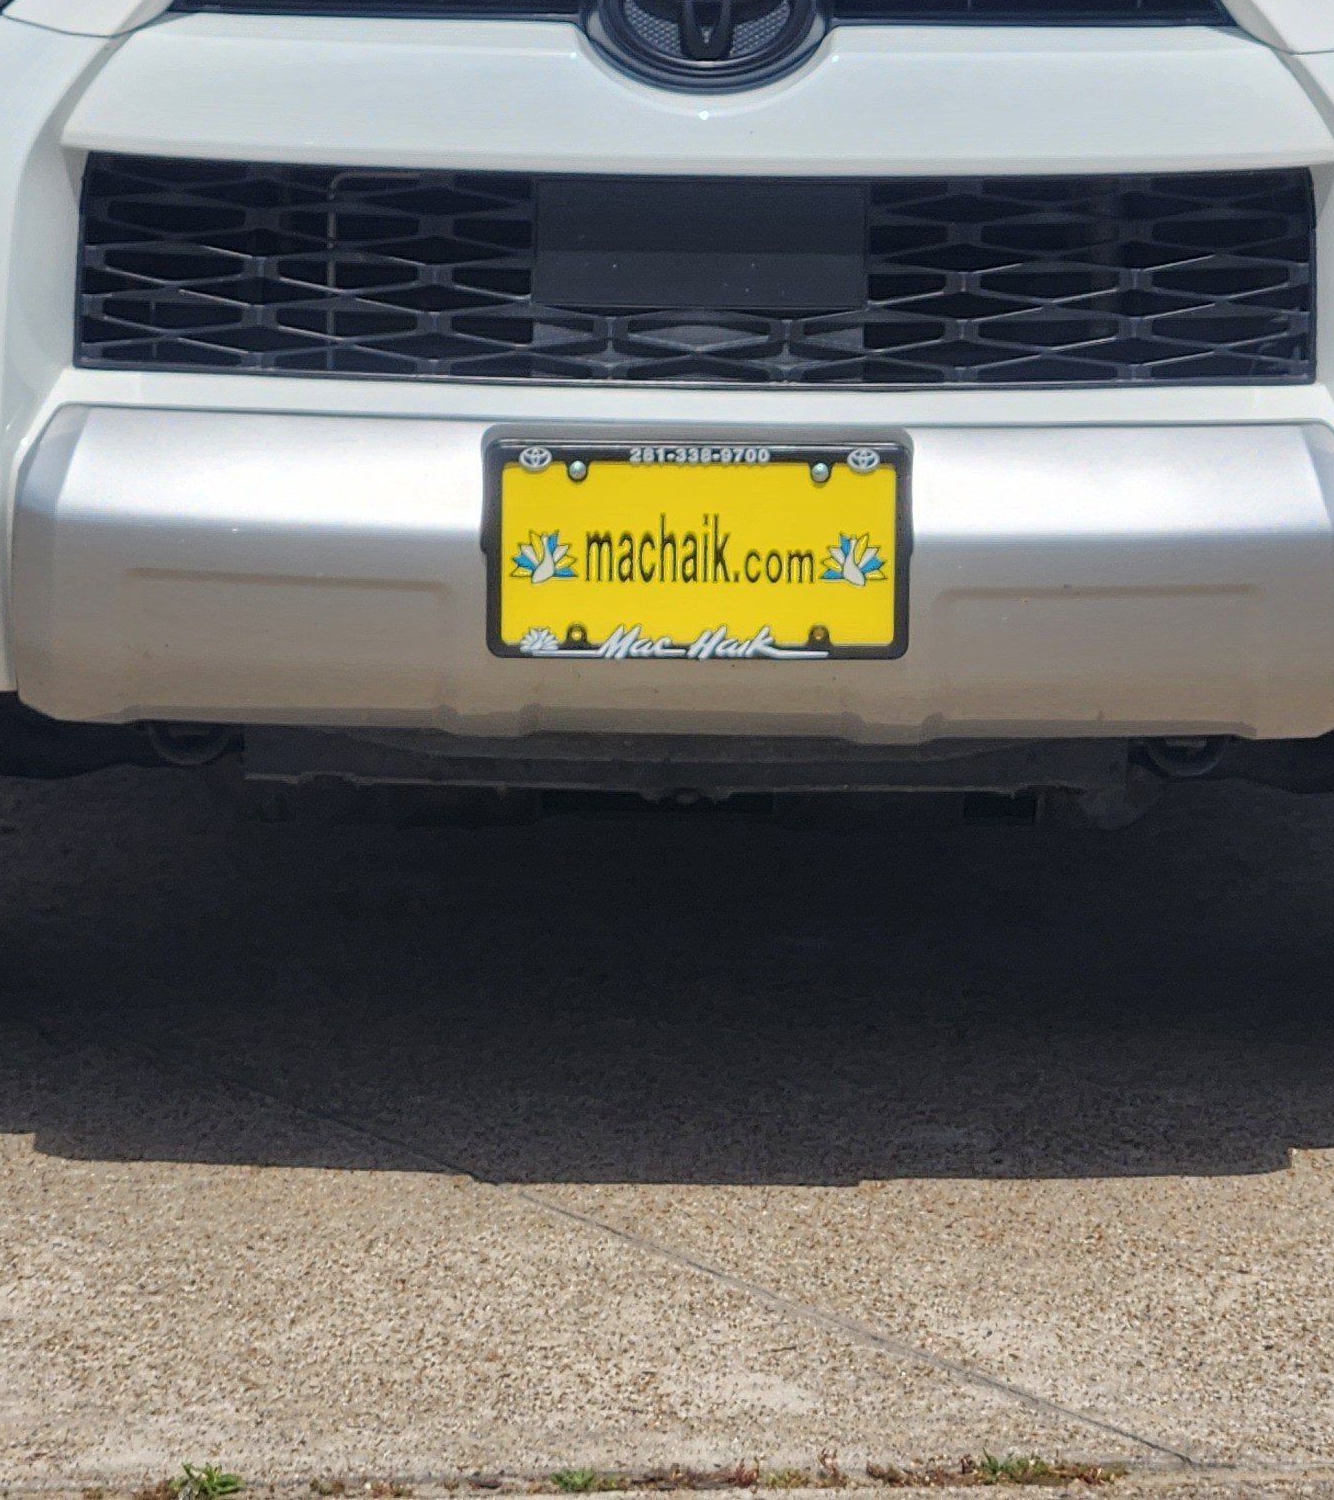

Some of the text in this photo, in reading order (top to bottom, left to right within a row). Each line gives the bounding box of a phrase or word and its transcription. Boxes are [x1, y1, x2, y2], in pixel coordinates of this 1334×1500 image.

[585, 513, 815, 584] machaik.com
[598, 624, 775, 660] Mac Haik
